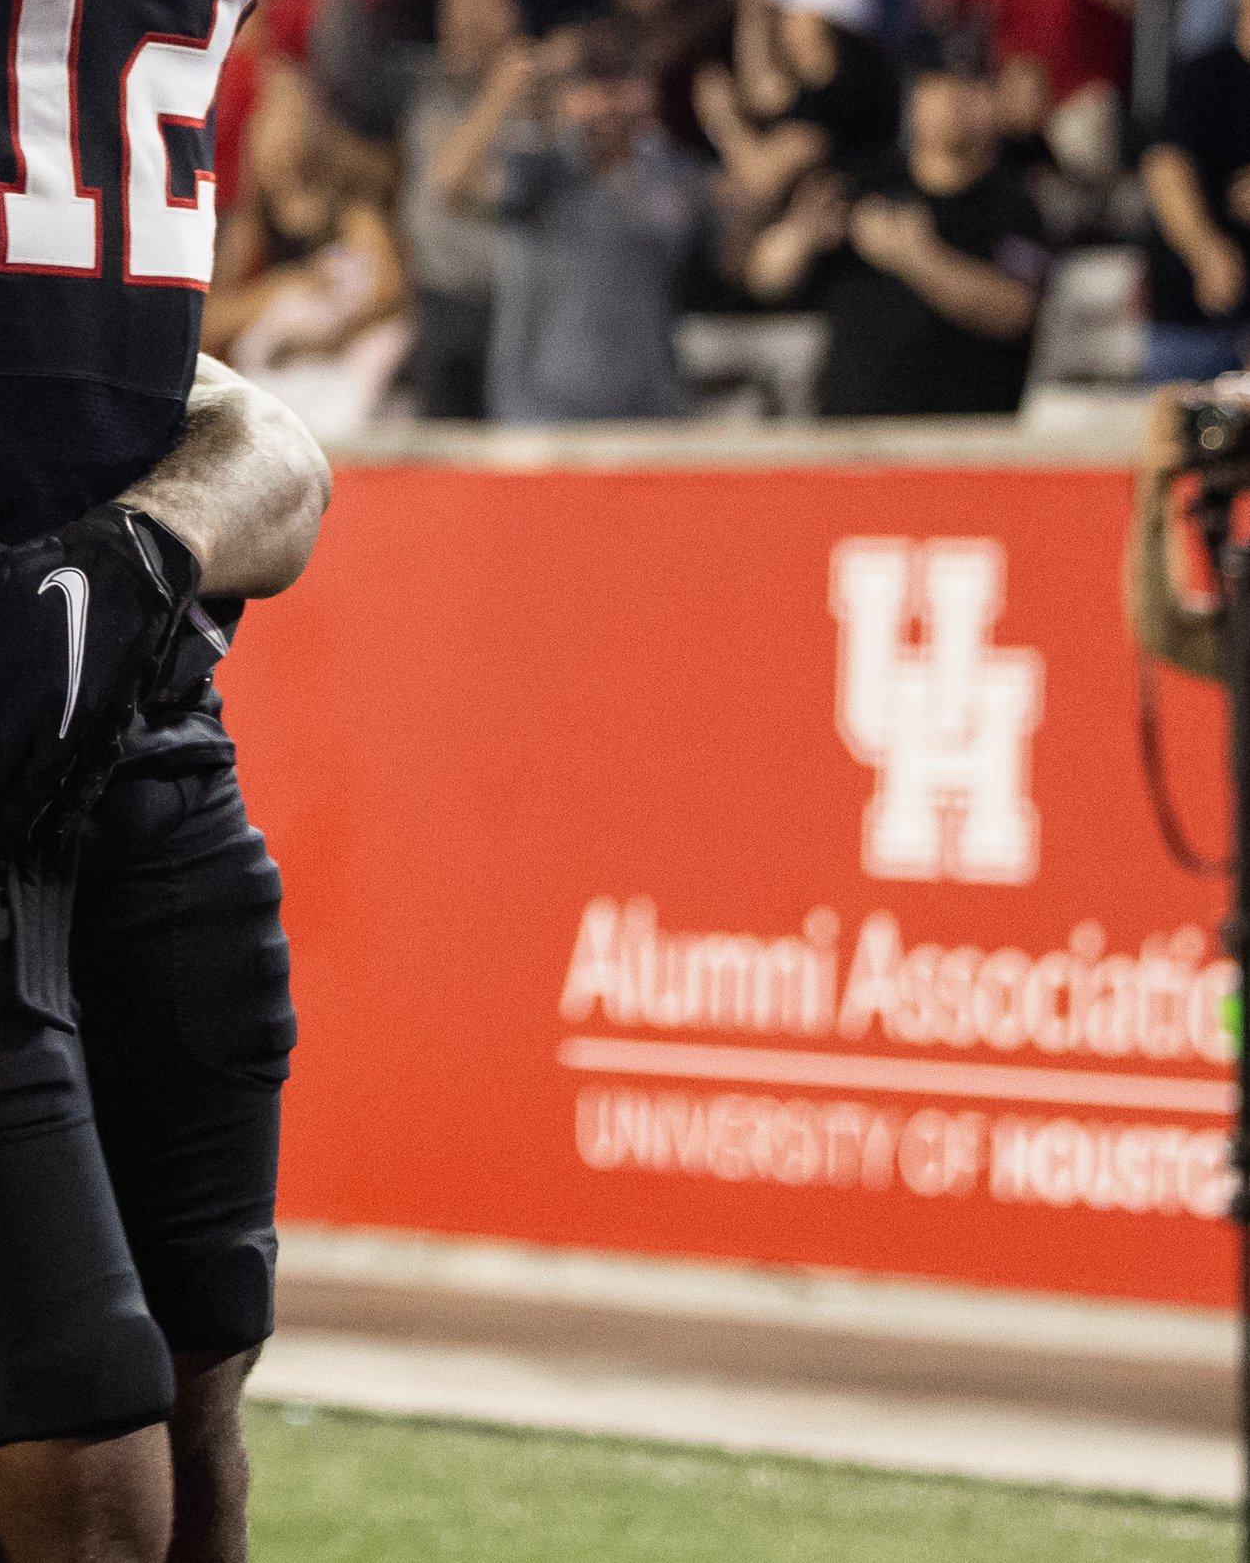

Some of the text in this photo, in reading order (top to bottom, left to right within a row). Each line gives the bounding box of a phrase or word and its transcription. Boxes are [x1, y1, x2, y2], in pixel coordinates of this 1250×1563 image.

[829, 536, 1047, 884] UH
[558, 895, 1242, 1066] Alumni Associatio
[575, 1084, 1244, 1218] UNIVERSITY OF HOUSTO
